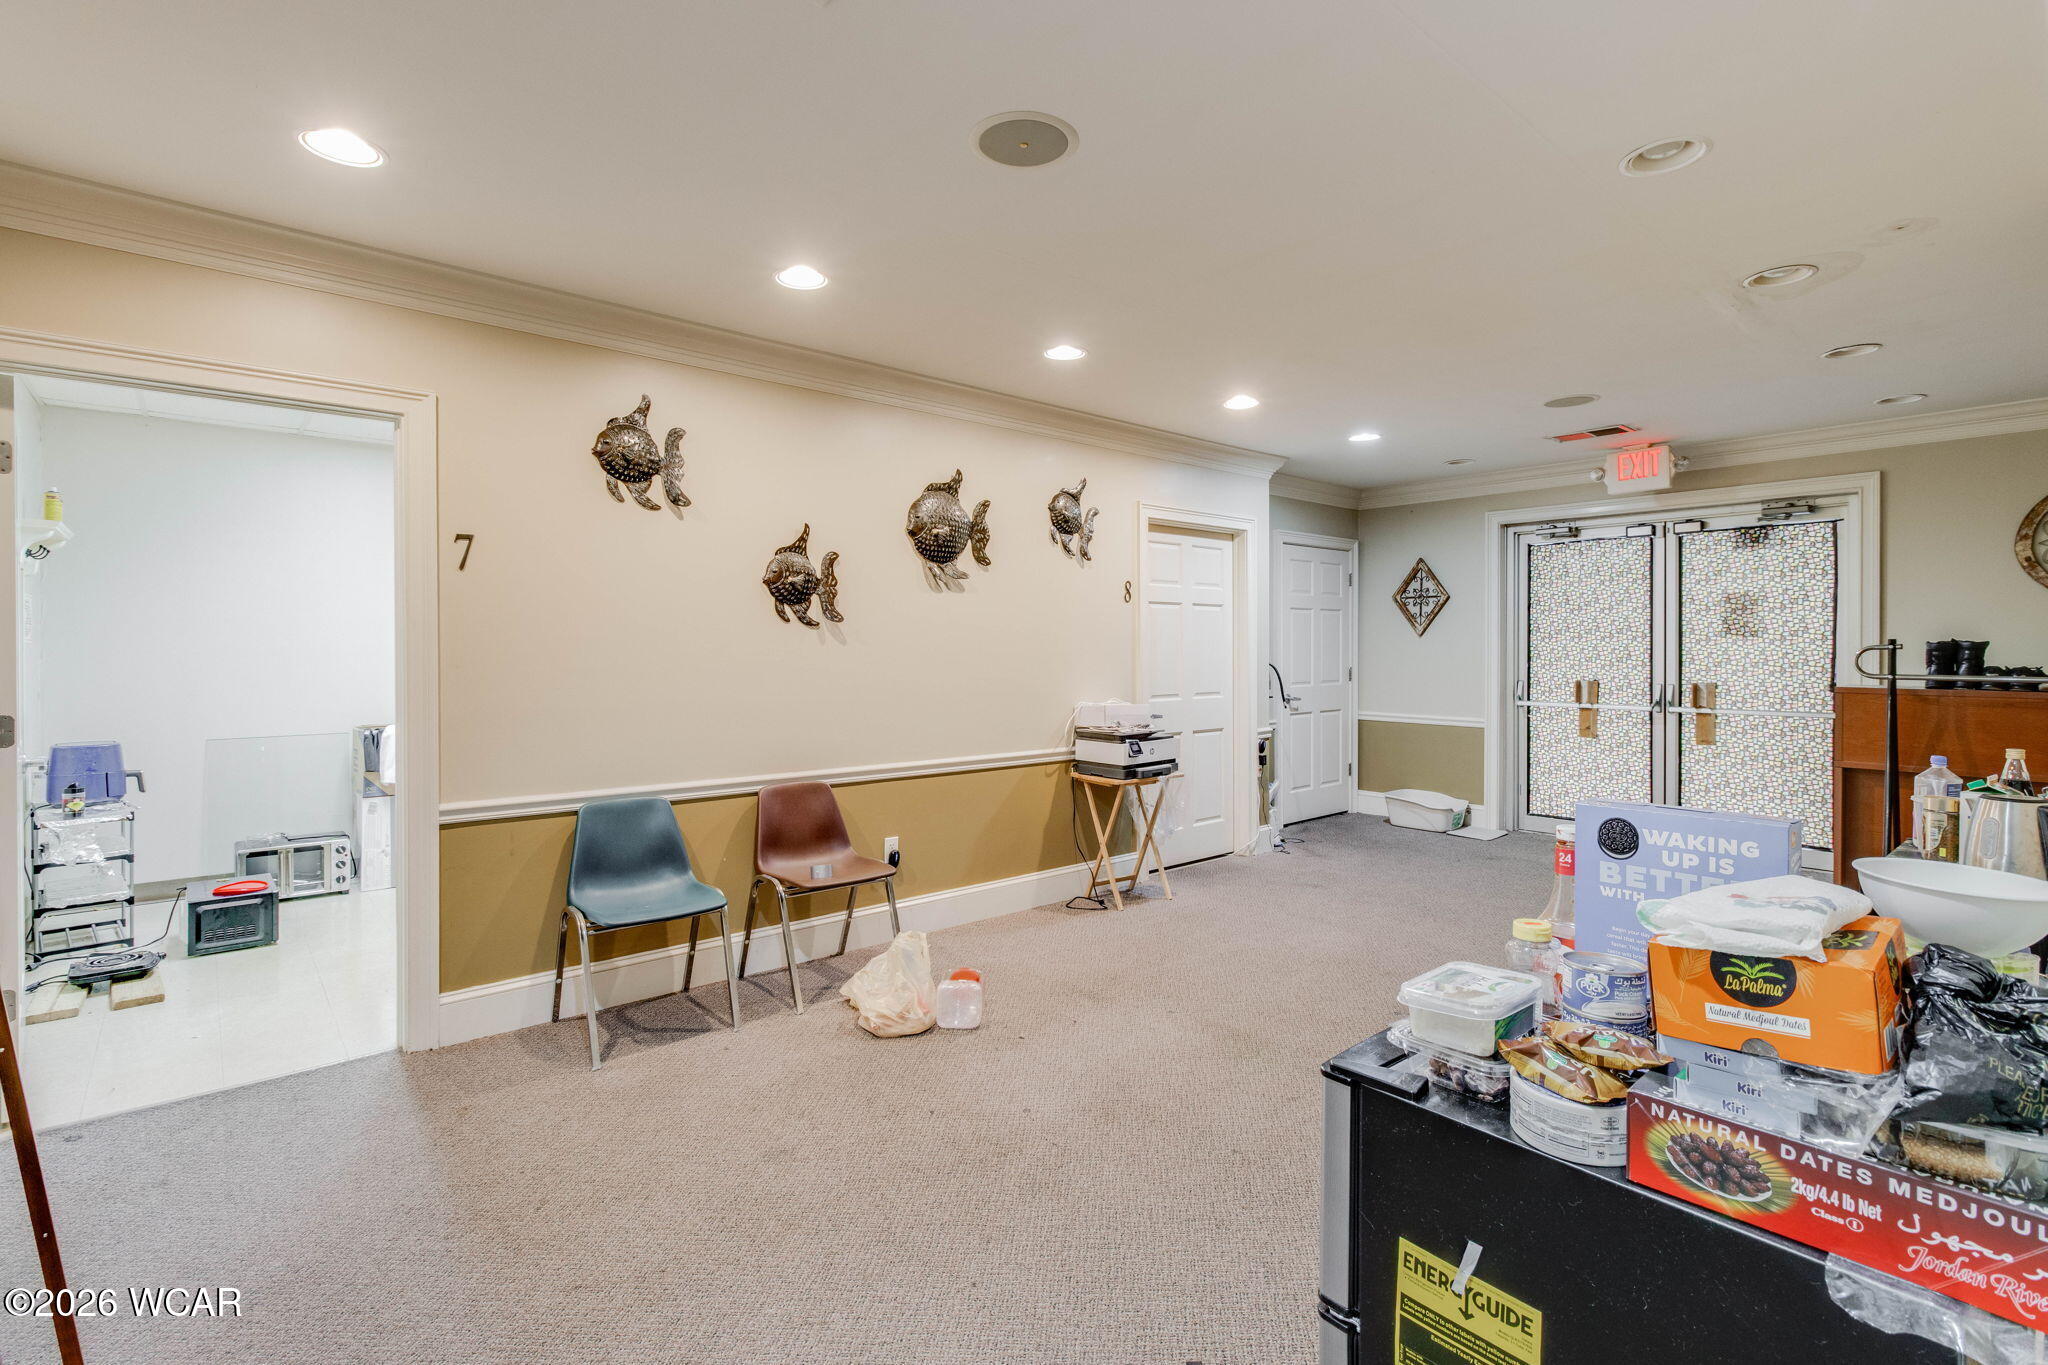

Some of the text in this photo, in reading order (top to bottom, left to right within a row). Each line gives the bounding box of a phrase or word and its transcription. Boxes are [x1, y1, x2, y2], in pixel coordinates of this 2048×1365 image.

[1617, 448, 1662, 481] EXIT
[453, 533, 475, 571] 7
[1124, 580, 1132, 603] 8
[1642, 828, 1760, 858] WAKING
[1558, 852, 1572, 863] 24
[1661, 851, 1735, 875] UP IS
[1599, 861, 1744, 895] BETT
[1600, 885, 1645, 901] WITH
[1708, 1005, 1807, 1031] Natural Medjoul Dates
[1704, 1051, 1728, 1067] Kiri
[1737, 1082, 1761, 1097] Kiri
[1722, 1099, 1746, 1116] Kiri
[1651, 1102, 1767, 1152] NATURAL
[1780, 1143, 1873, 1186] DATES
[1888, 1177, 2048, 1243] MEDJOUL
[1790, 1176, 1883, 1222] 2kg/4.4 lb Net
[1810, 1206, 1845, 1225] Class
[1898, 1246, 2048, 1320] Jordan Rive
